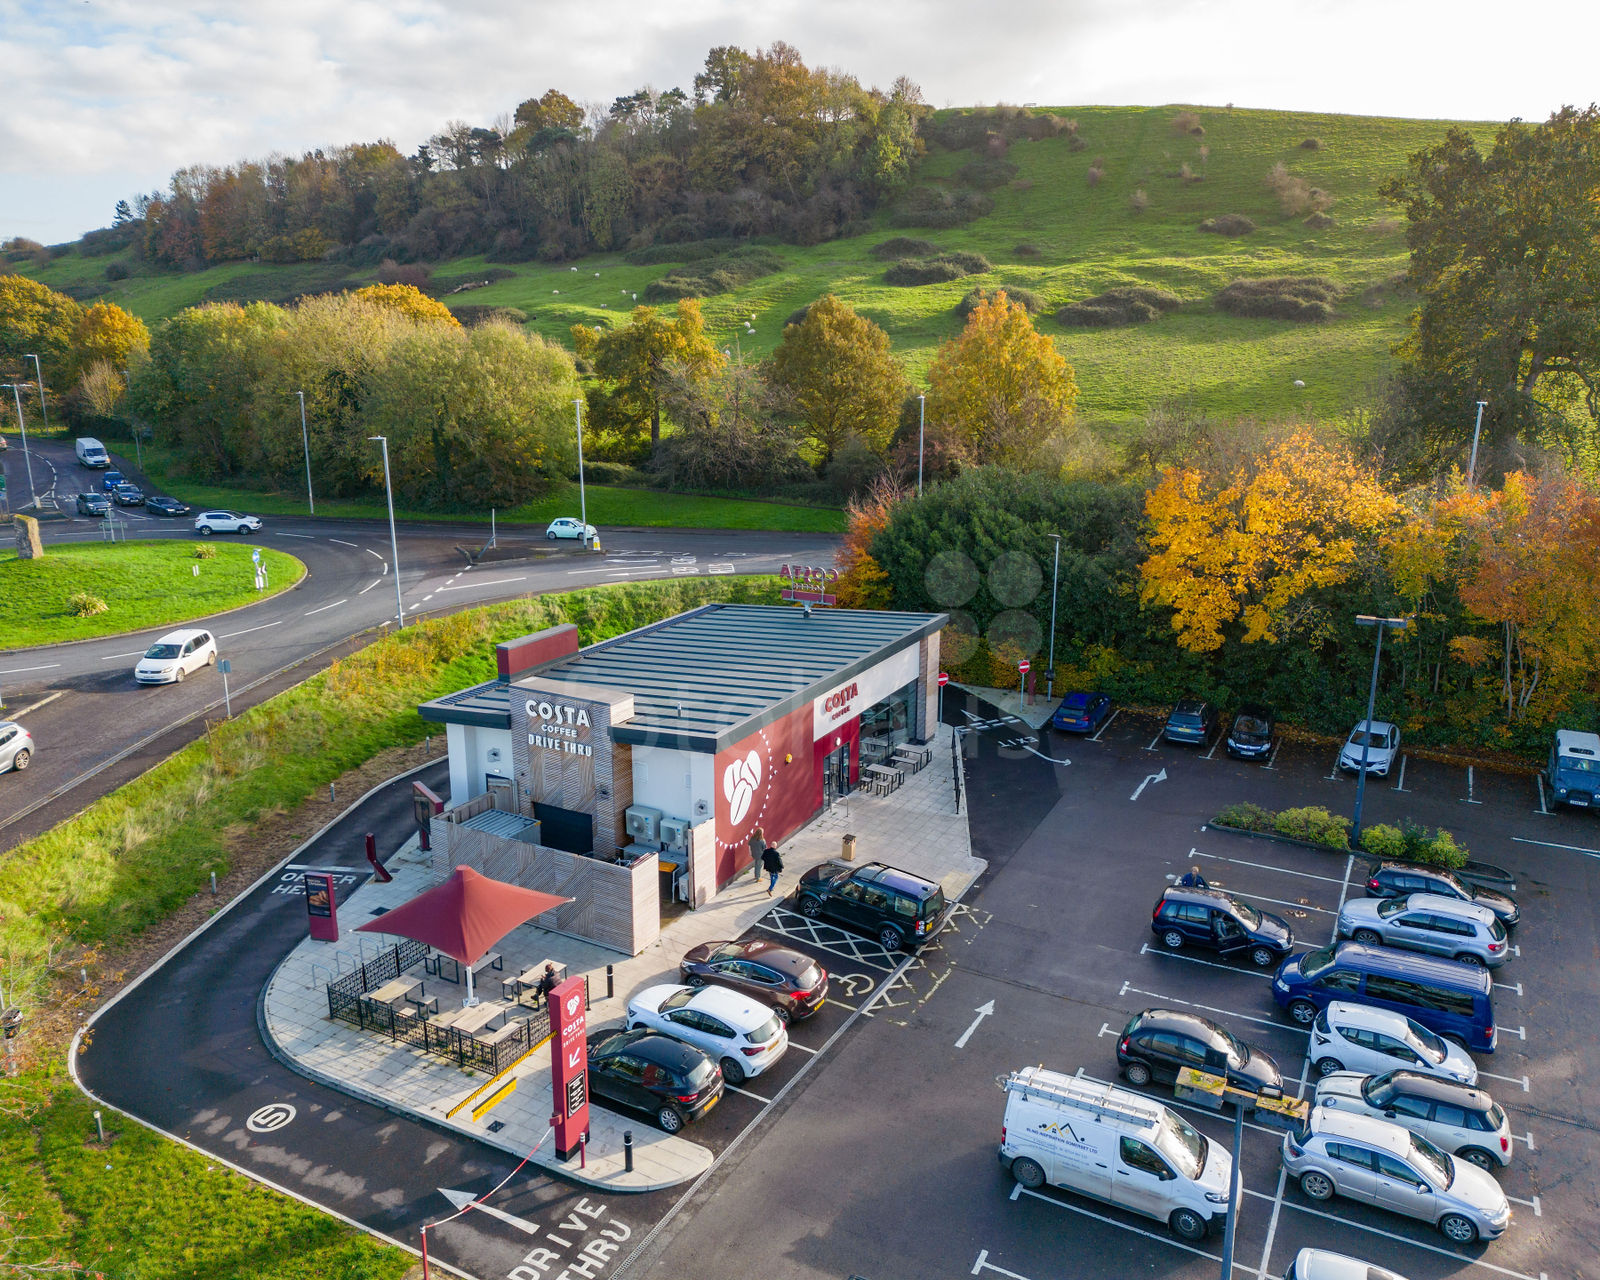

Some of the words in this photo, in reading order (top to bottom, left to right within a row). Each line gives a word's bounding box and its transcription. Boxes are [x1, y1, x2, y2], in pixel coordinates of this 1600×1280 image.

[825, 682, 858, 712] COSTA
[525, 699, 592, 728] COSTA
[832, 705, 850, 720] COFFEE
[541, 724, 577, 738] COFFEE
[528, 733, 561, 751] DRIVE
[564, 741, 593, 757] THRU
[997, 736, 1039, 748] EXIT
[562, 1015, 585, 1036] COSTA
[1065, 1139, 1089, 1152] SOMERSET
[506, 1197, 607, 1280] DRIVE
